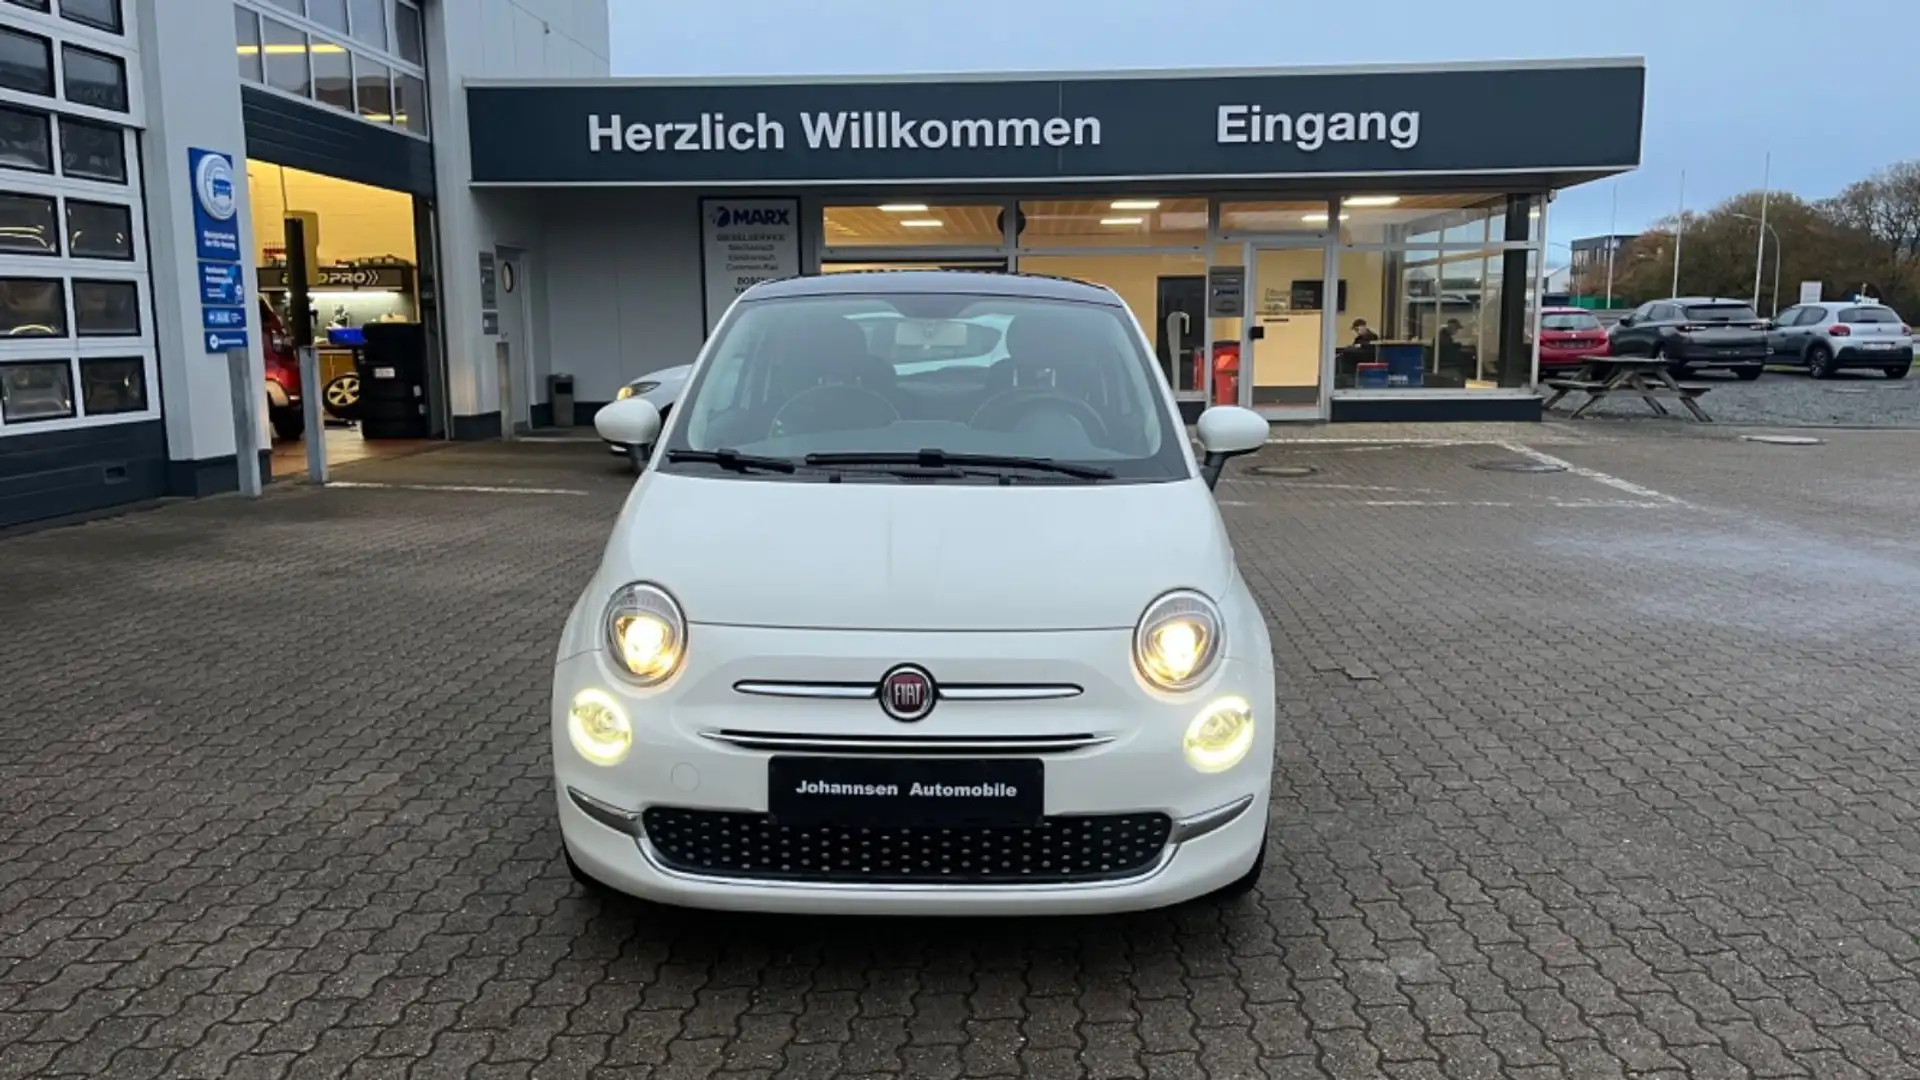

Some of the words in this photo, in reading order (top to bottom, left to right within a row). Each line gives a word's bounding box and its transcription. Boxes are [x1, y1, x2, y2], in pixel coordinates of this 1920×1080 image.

[588, 112, 785, 153] Herzlich
[799, 110, 1102, 150] Willkommen
[1217, 104, 1420, 151] Eingang
[733, 208, 790, 226] MARX
[894, 683, 921, 704] FIAT
[795, 779, 899, 796] Johannsen
[909, 782, 1018, 797] Automobile
